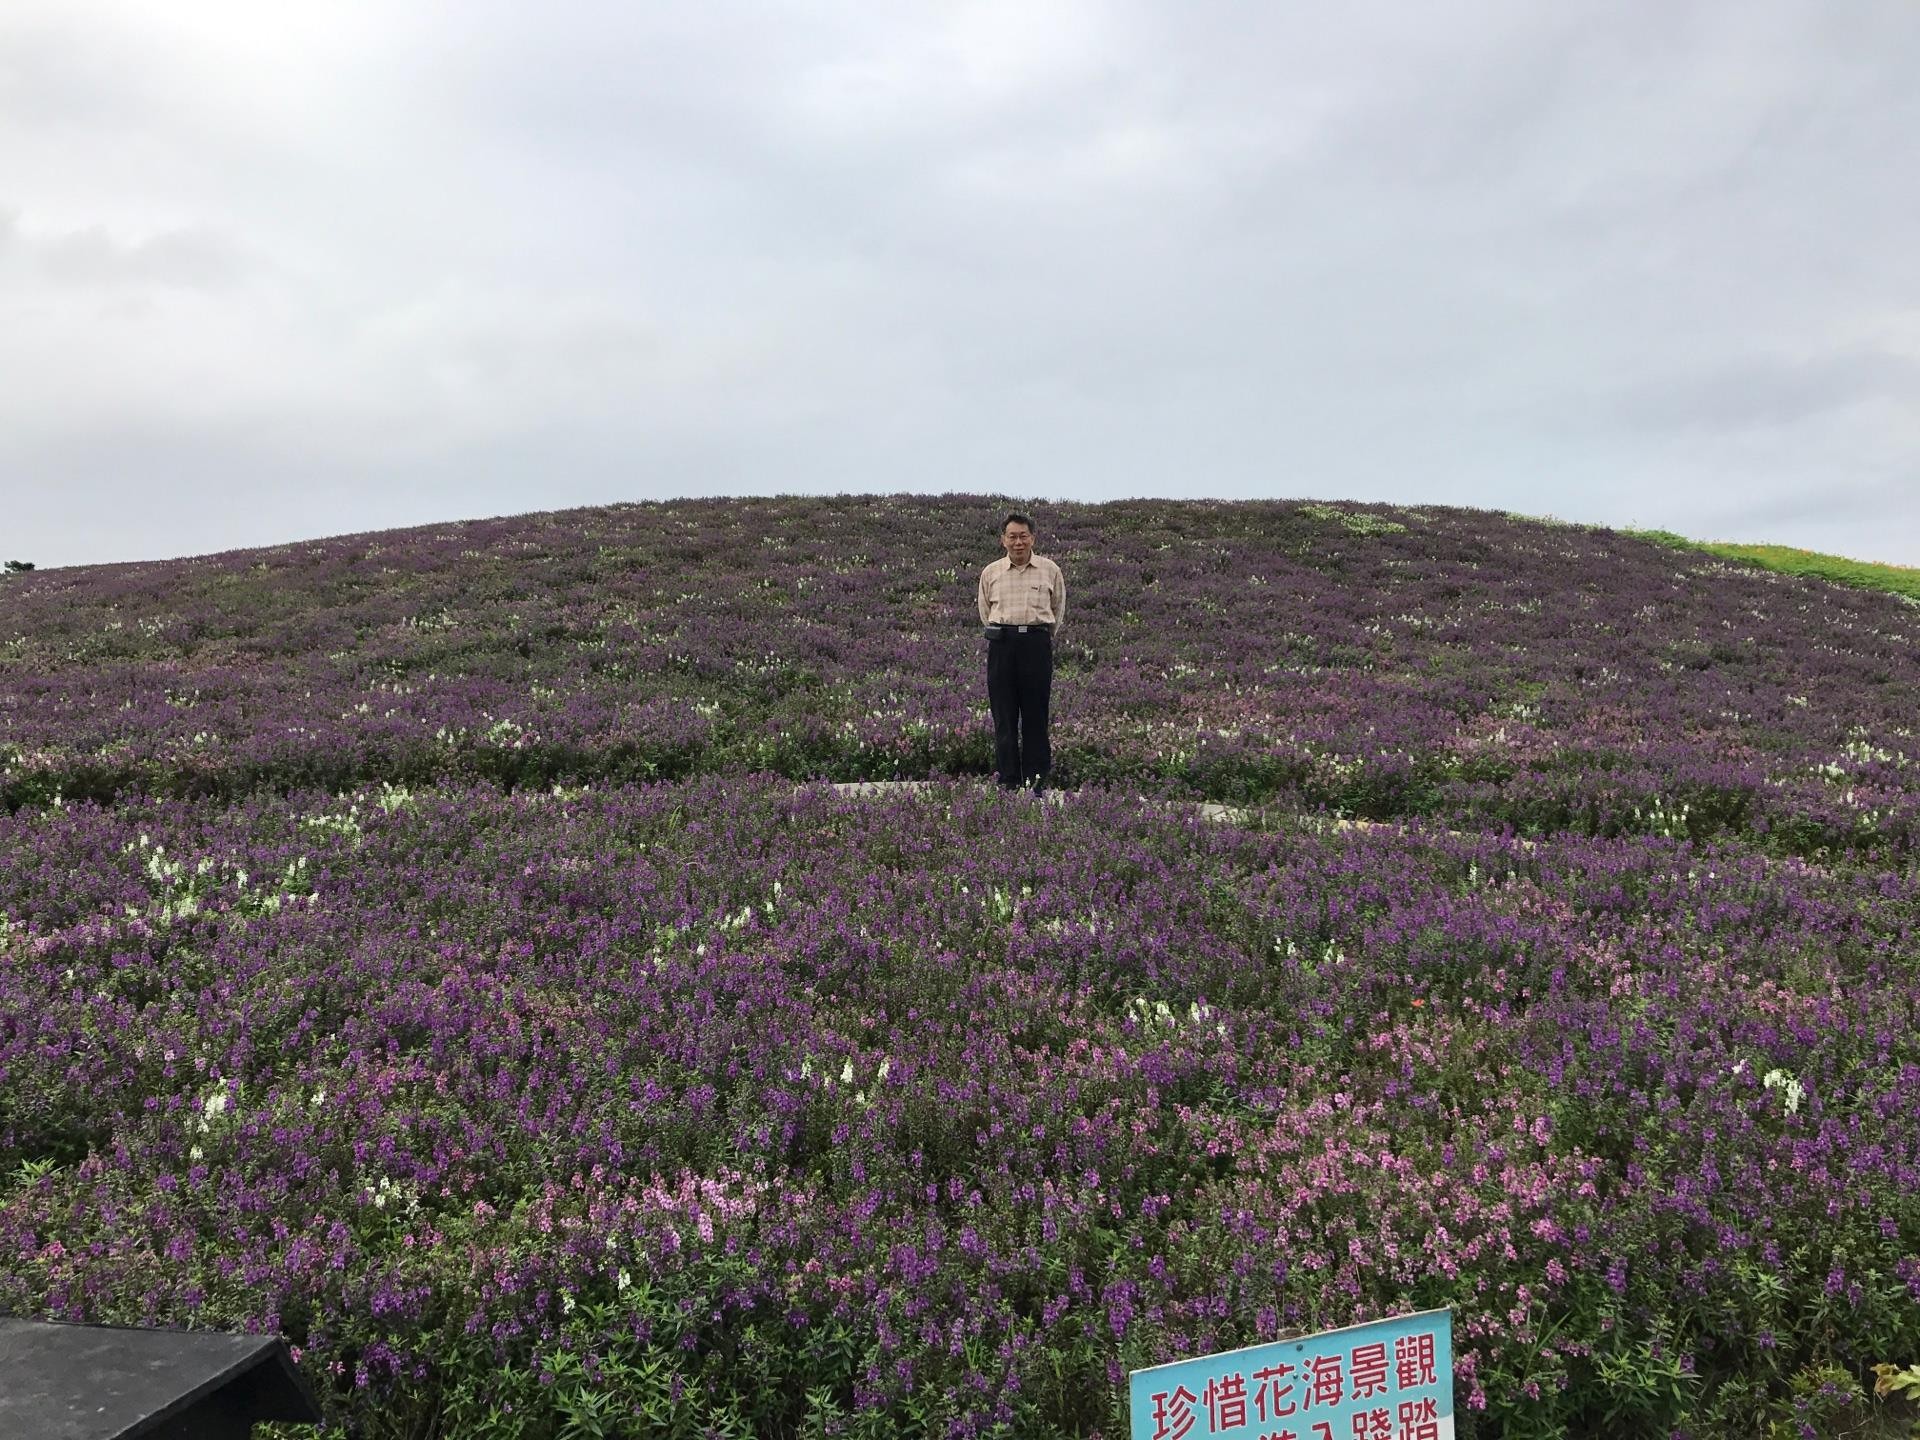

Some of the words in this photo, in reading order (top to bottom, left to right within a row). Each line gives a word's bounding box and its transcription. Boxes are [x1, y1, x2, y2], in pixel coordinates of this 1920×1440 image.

[1151, 1333, 1437, 1440] 珍惜花海景觀
[1258, 1396, 1439, 1440] 踐踏
